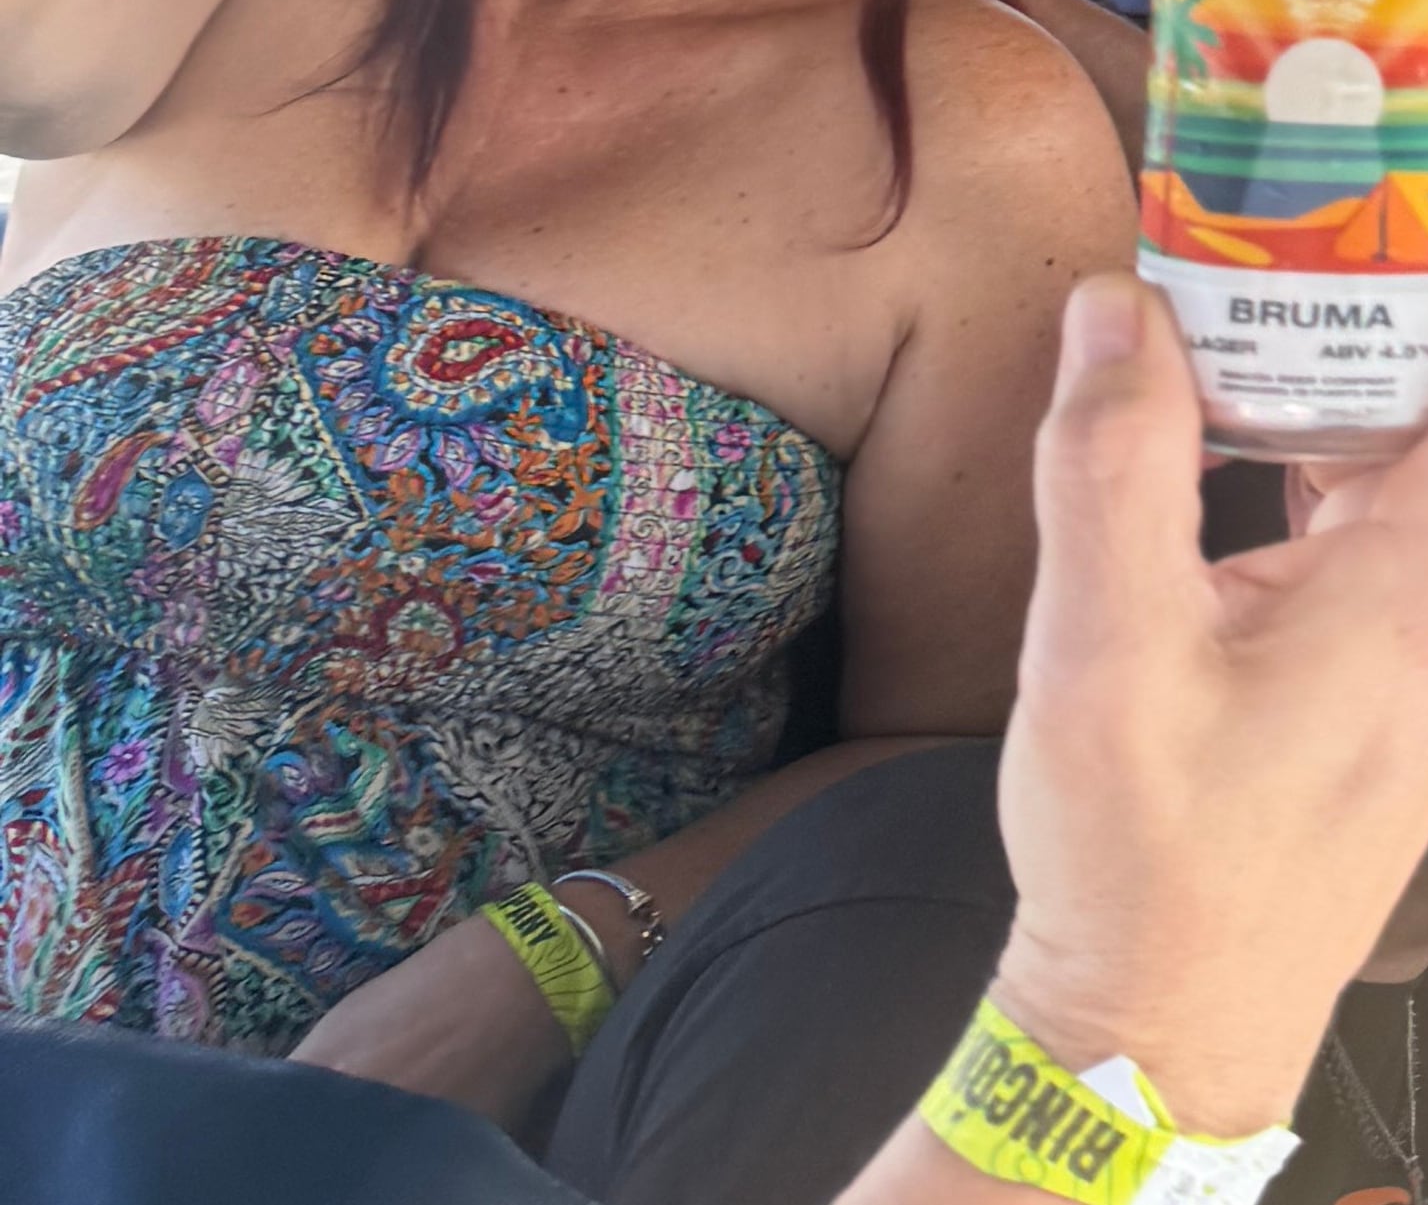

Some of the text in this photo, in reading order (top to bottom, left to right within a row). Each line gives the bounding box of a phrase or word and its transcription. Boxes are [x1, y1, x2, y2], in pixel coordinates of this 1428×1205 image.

[1229, 297, 1393, 330] BRUMA
[1190, 335, 1258, 356] LAGER
[1320, 344, 1370, 360] ABV
[497, 886, 560, 947] PANY
